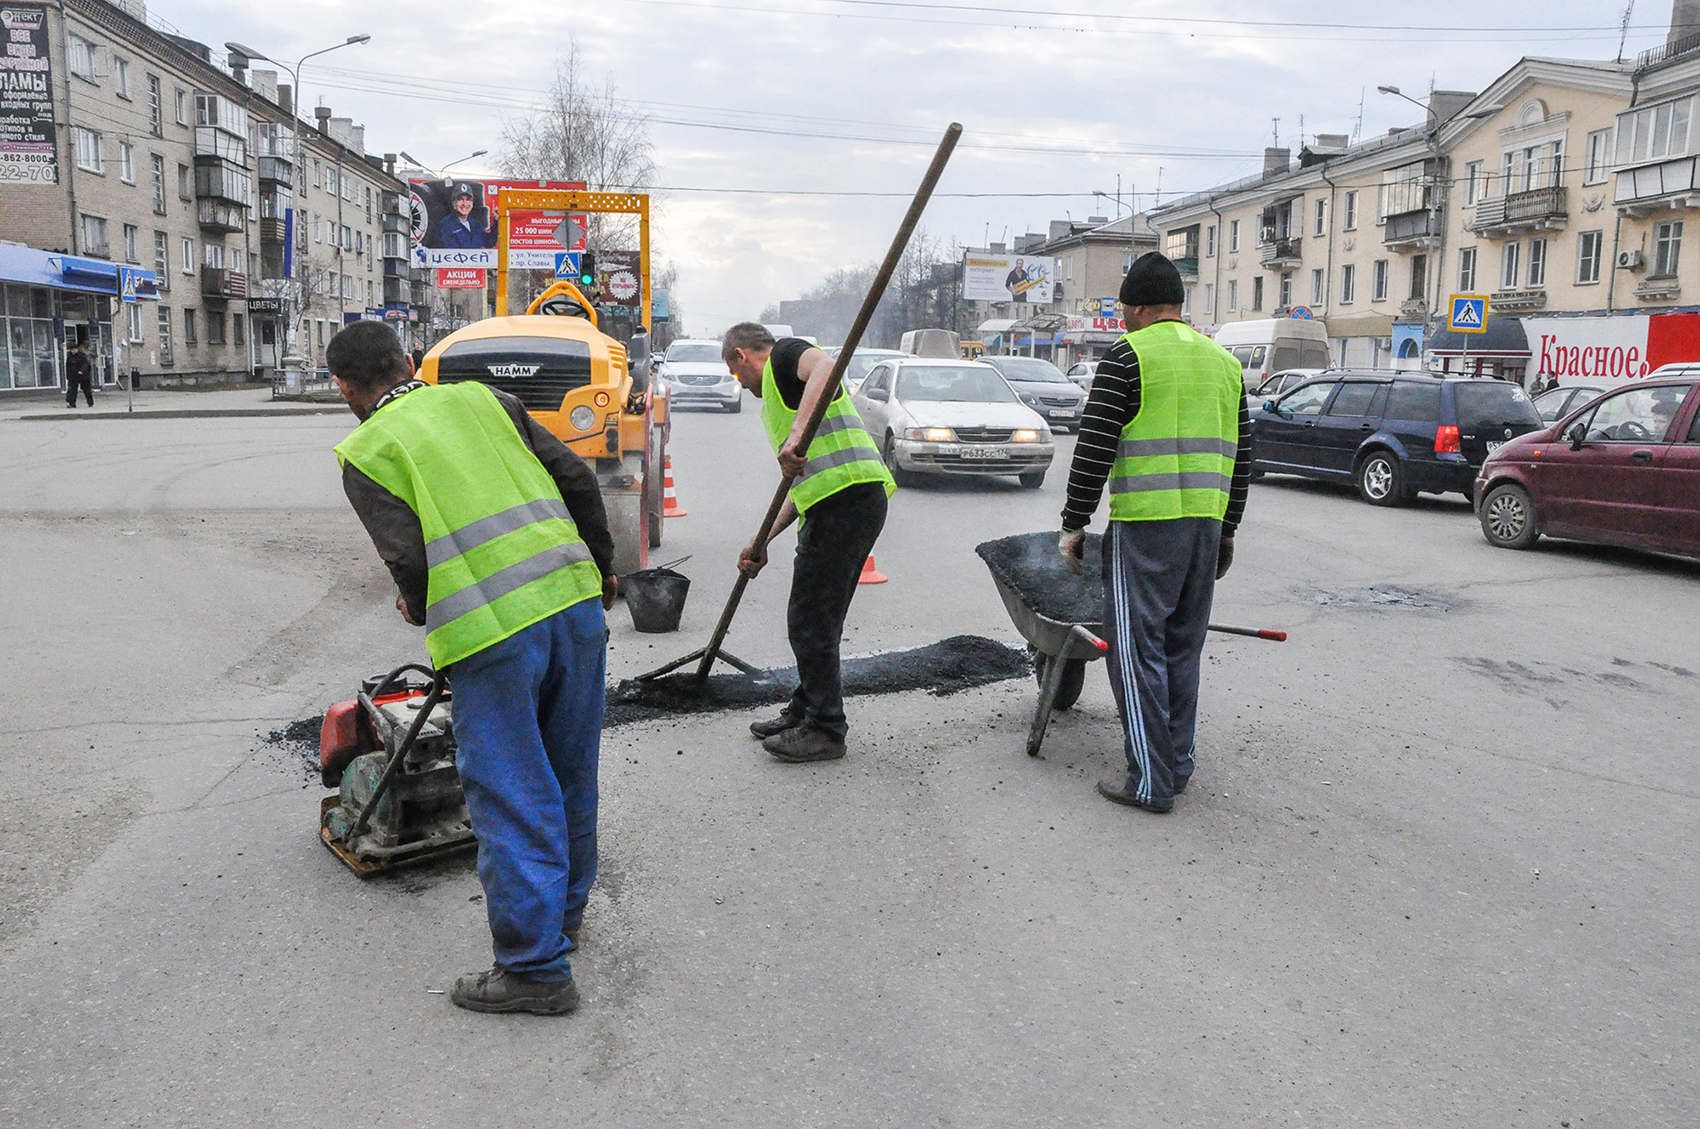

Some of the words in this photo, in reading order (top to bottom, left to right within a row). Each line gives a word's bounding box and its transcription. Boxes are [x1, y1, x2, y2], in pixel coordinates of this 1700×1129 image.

[10, 30, 30, 42] ВСЕ
[7, 43, 36, 57] ВИДЫ
[32, 102, 52, 112] групп
[447, 271, 476, 279] АКЦИИ
[249, 301, 278, 310] ЦВЕТЫ
[1540, 335, 1639, 381] Красное
[496, 367, 531, 375] HAMM
